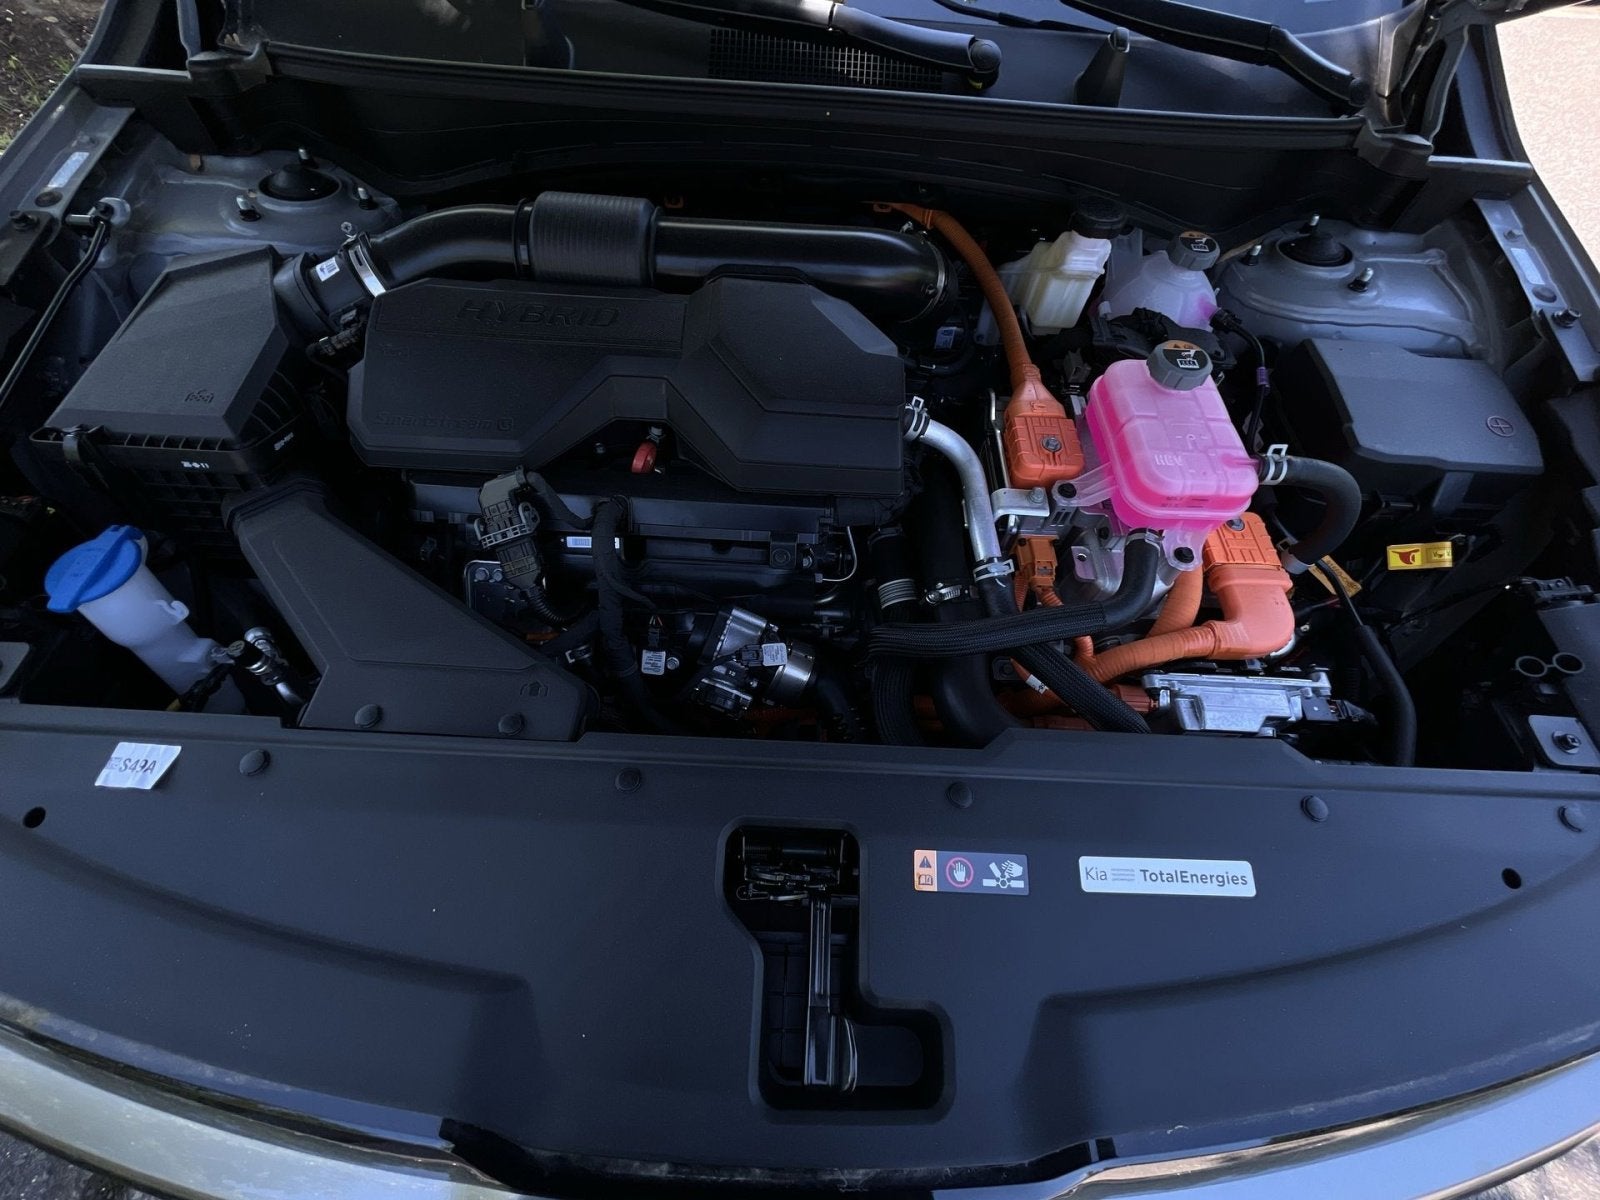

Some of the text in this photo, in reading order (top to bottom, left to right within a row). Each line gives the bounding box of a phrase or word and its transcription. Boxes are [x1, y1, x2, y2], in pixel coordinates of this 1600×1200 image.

[455, 299, 620, 327] HYBRID
[119, 757, 158, 775] S49A
[1084, 866, 1249, 888] Kia TotalEnergies
